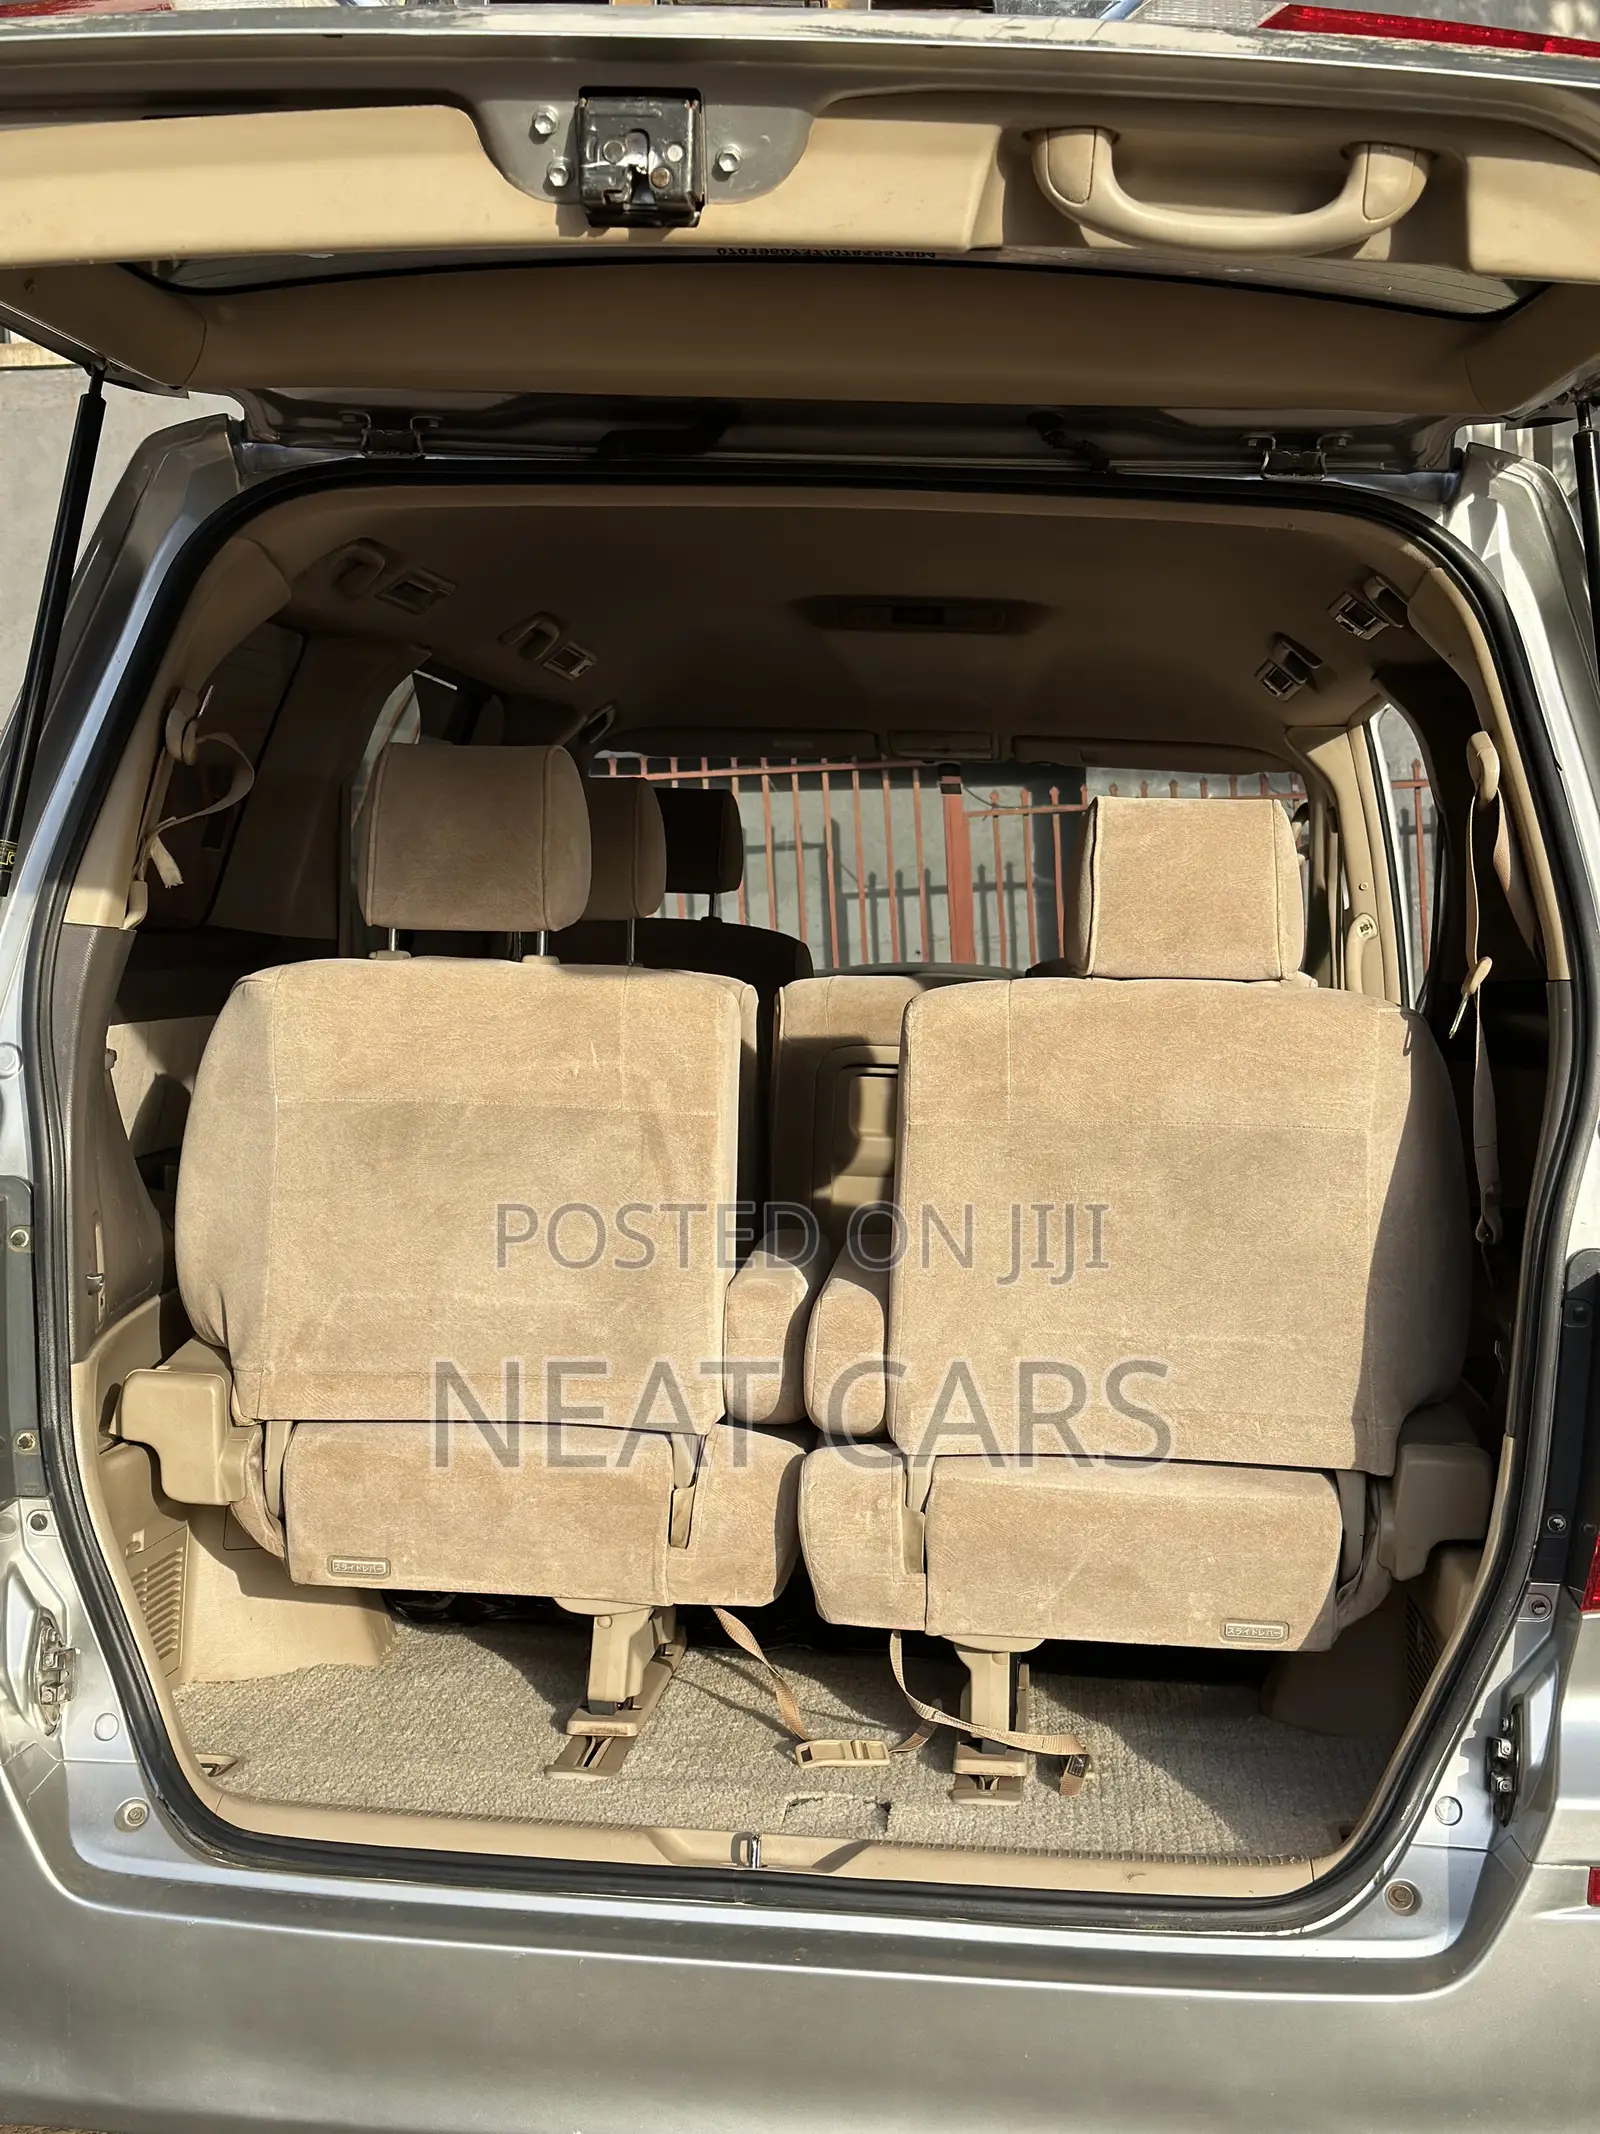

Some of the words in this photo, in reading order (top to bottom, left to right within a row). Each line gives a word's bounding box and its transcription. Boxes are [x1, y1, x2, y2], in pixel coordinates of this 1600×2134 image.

[1227, 1627, 1281, 1636] スライドレバー
